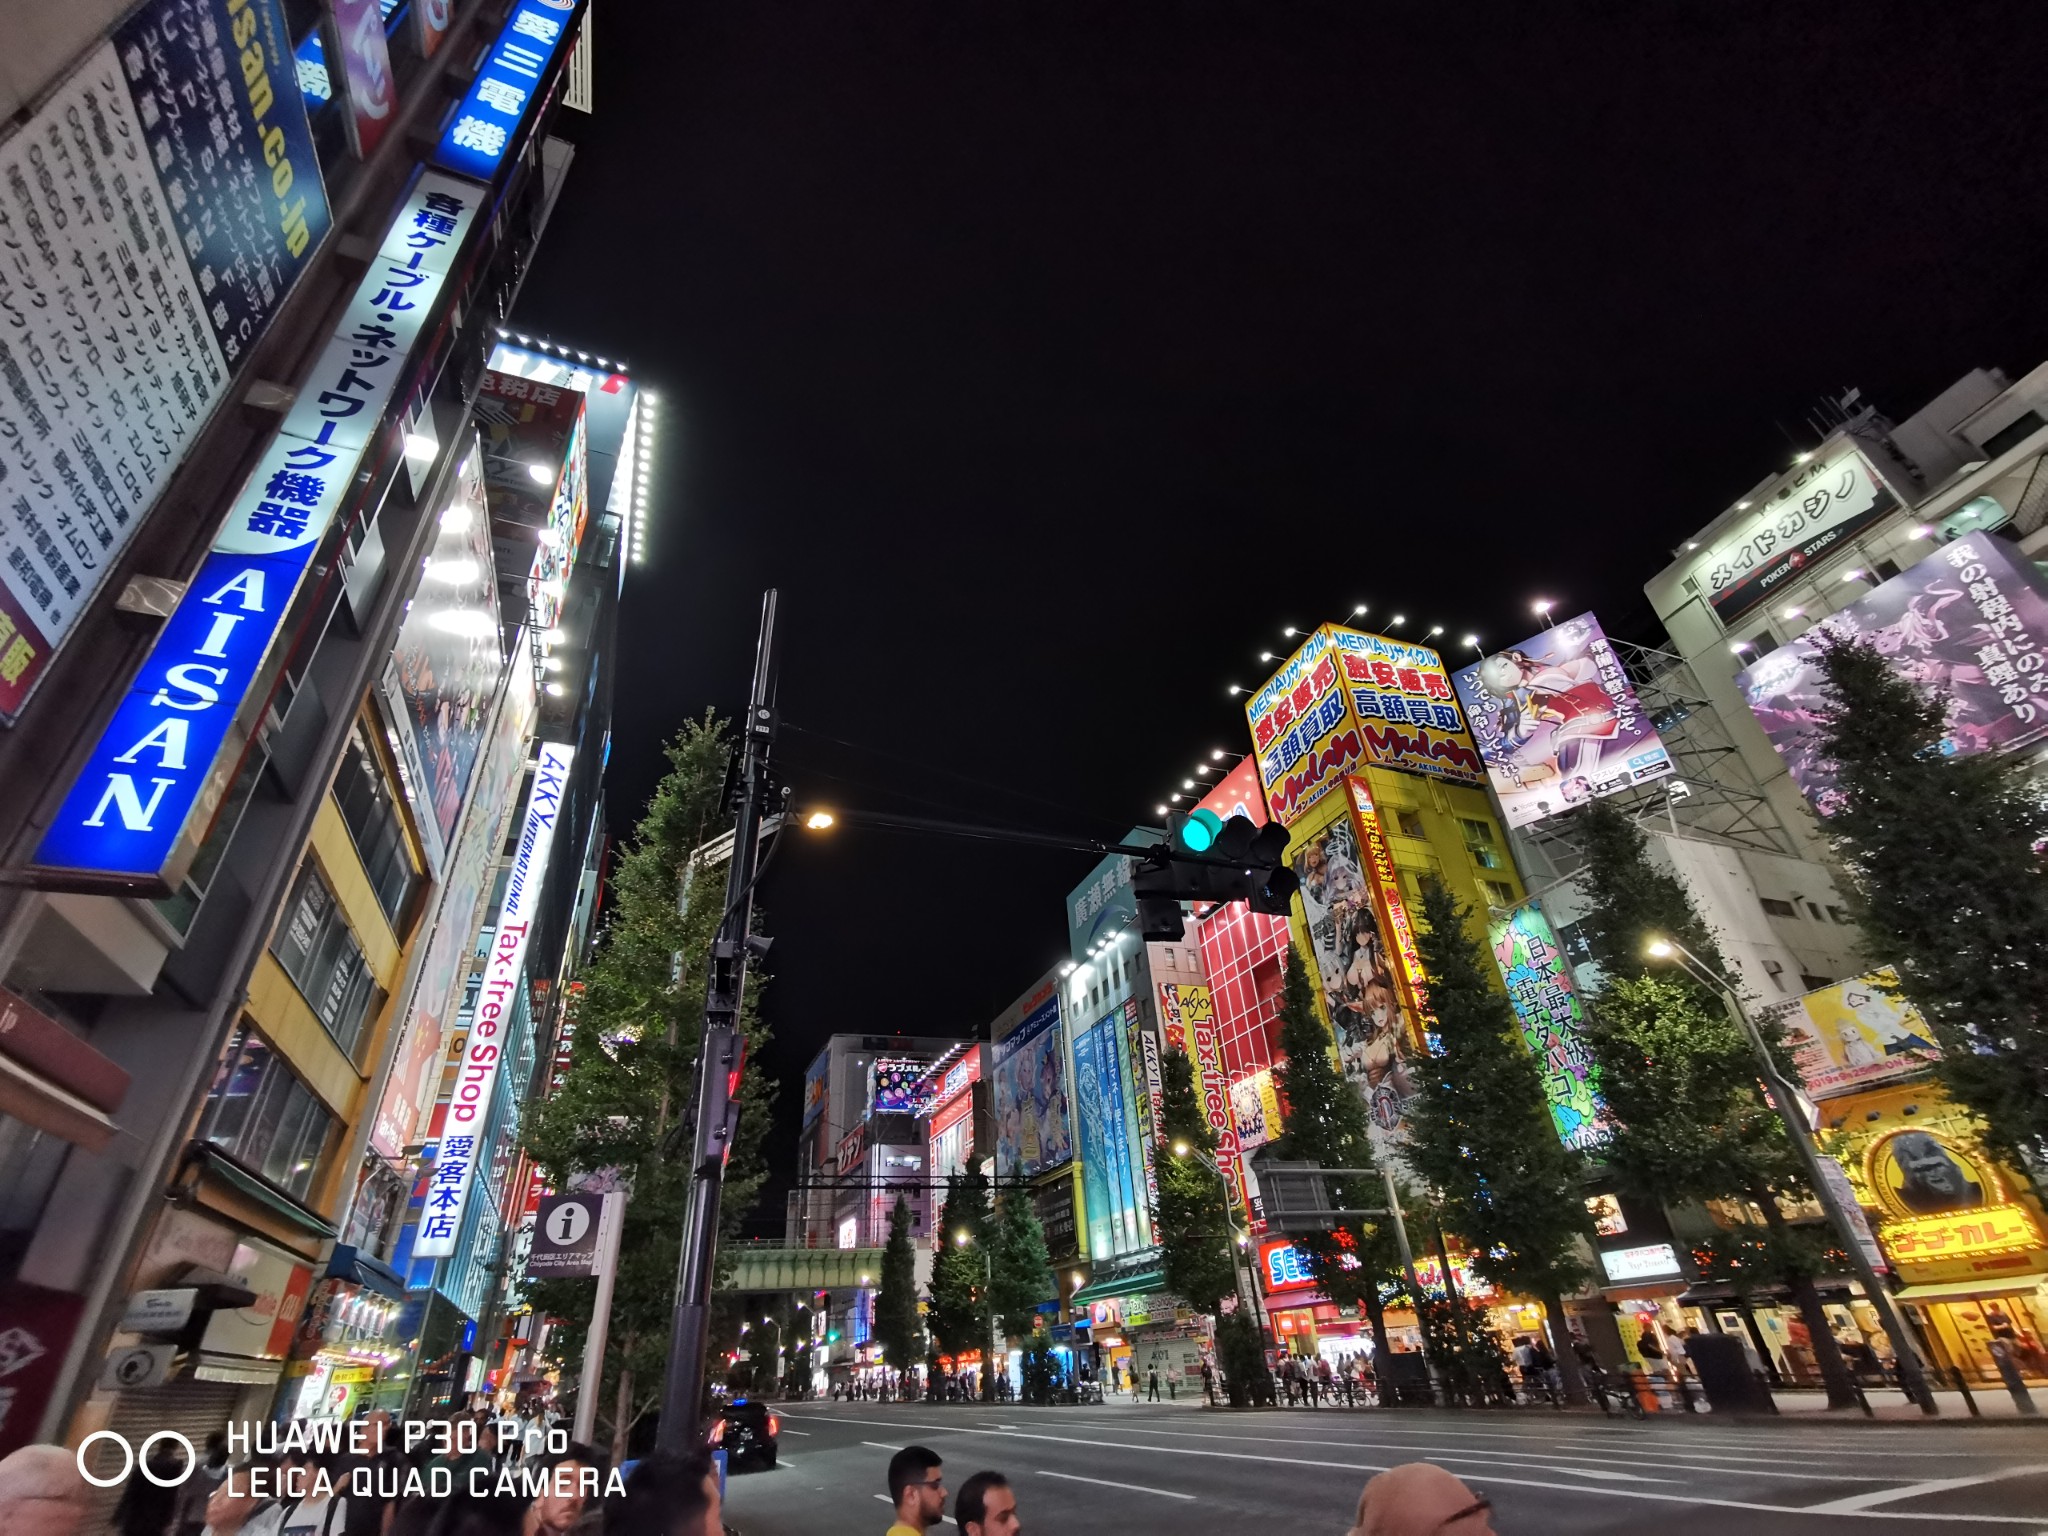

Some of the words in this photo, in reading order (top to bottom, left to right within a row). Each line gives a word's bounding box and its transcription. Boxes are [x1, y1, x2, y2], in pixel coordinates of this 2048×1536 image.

[452, 9, 560, 157] 愛三電機
[247, 191, 466, 540] 各種ケーブル・ネットワーク機器
[1711, 469, 1856, 590] メイドカジノ
[1761, 564, 1791, 587] POKER
[1804, 531, 1837, 557] STARS
[1249, 632, 1326, 723] MEDIAリサイクル
[1333, 632, 1440, 667] MEDIAリサイクル
[1342, 653, 1452, 699] 激安販売
[1462, 671, 1497, 714] いつでも
[1589, 638, 1642, 737] 準備は整ったぞ。
[1975, 644, 2036, 724] 真理あり
[82, 567, 265, 832] AISAN
[1255, 655, 1337, 750] 激安販売
[1263, 689, 1345, 787] 高額買取
[1352, 687, 1464, 732] 高額買取
[535, 752, 565, 829] AKKY
[1270, 729, 1362, 823] Mulan
[1363, 725, 1482, 773] Mulan
[505, 808, 539, 916] INTERNATIONAL
[482, 921, 528, 1037] Tax-free
[1527, 935, 1588, 1065] 日本最大級
[1144, 1035, 1159, 1078] AKKY
[1193, 1015, 1226, 1131] Tax-free
[1517, 976, 1573, 1097] 電子タバコ
[454, 1044, 497, 1122] Shop
[529, 1260, 553, 1268] Chiyoda
[581, 1258, 593, 1266] Map
[530, 1251, 594, 1262] 千代田区エリアマップ
[1894, 1221, 2024, 1254] ゴーゴーカレー
